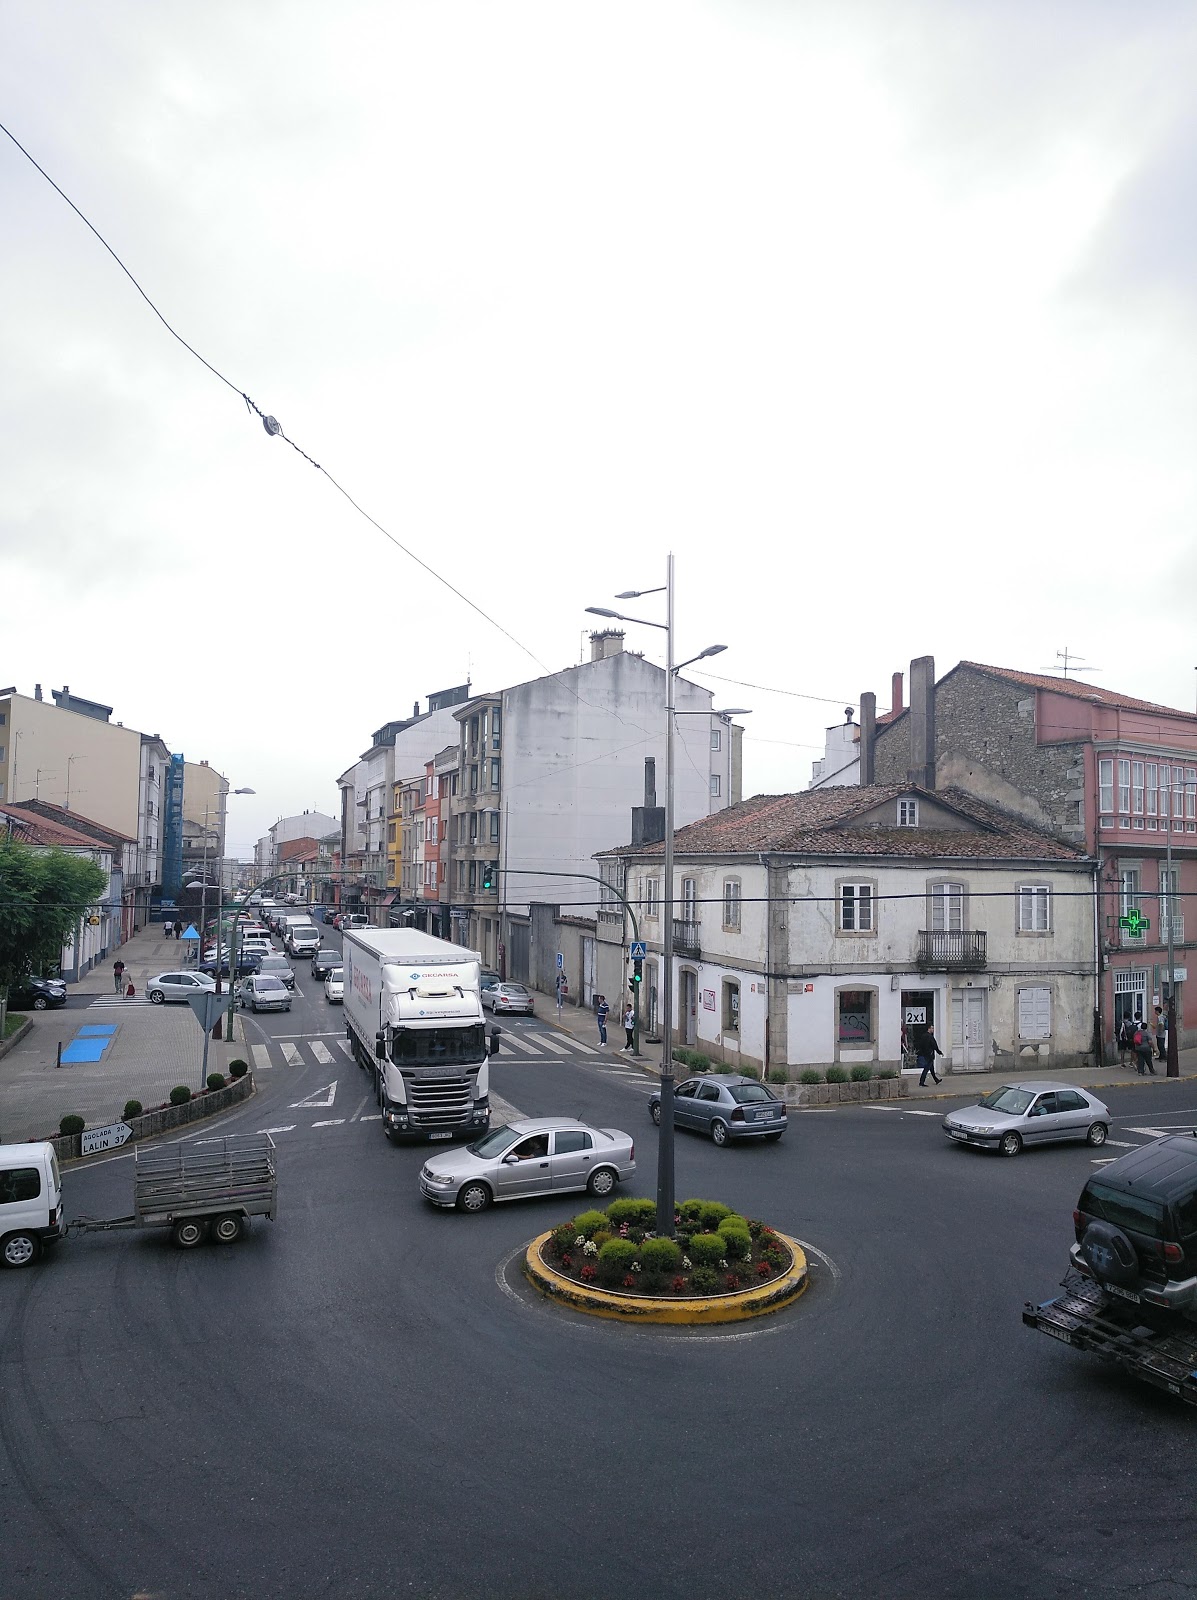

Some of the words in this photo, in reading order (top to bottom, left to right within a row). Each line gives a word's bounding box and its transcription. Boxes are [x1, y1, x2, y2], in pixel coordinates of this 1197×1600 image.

[906, 1012, 925, 1023] 2x1
[422, 1069, 459, 1077] SCANIA
[83, 1129, 112, 1141] AGOLADA
[116, 1125, 125, 1133] 20
[83, 1139, 109, 1153] LALIN
[114, 1134, 125, 1144] 37
